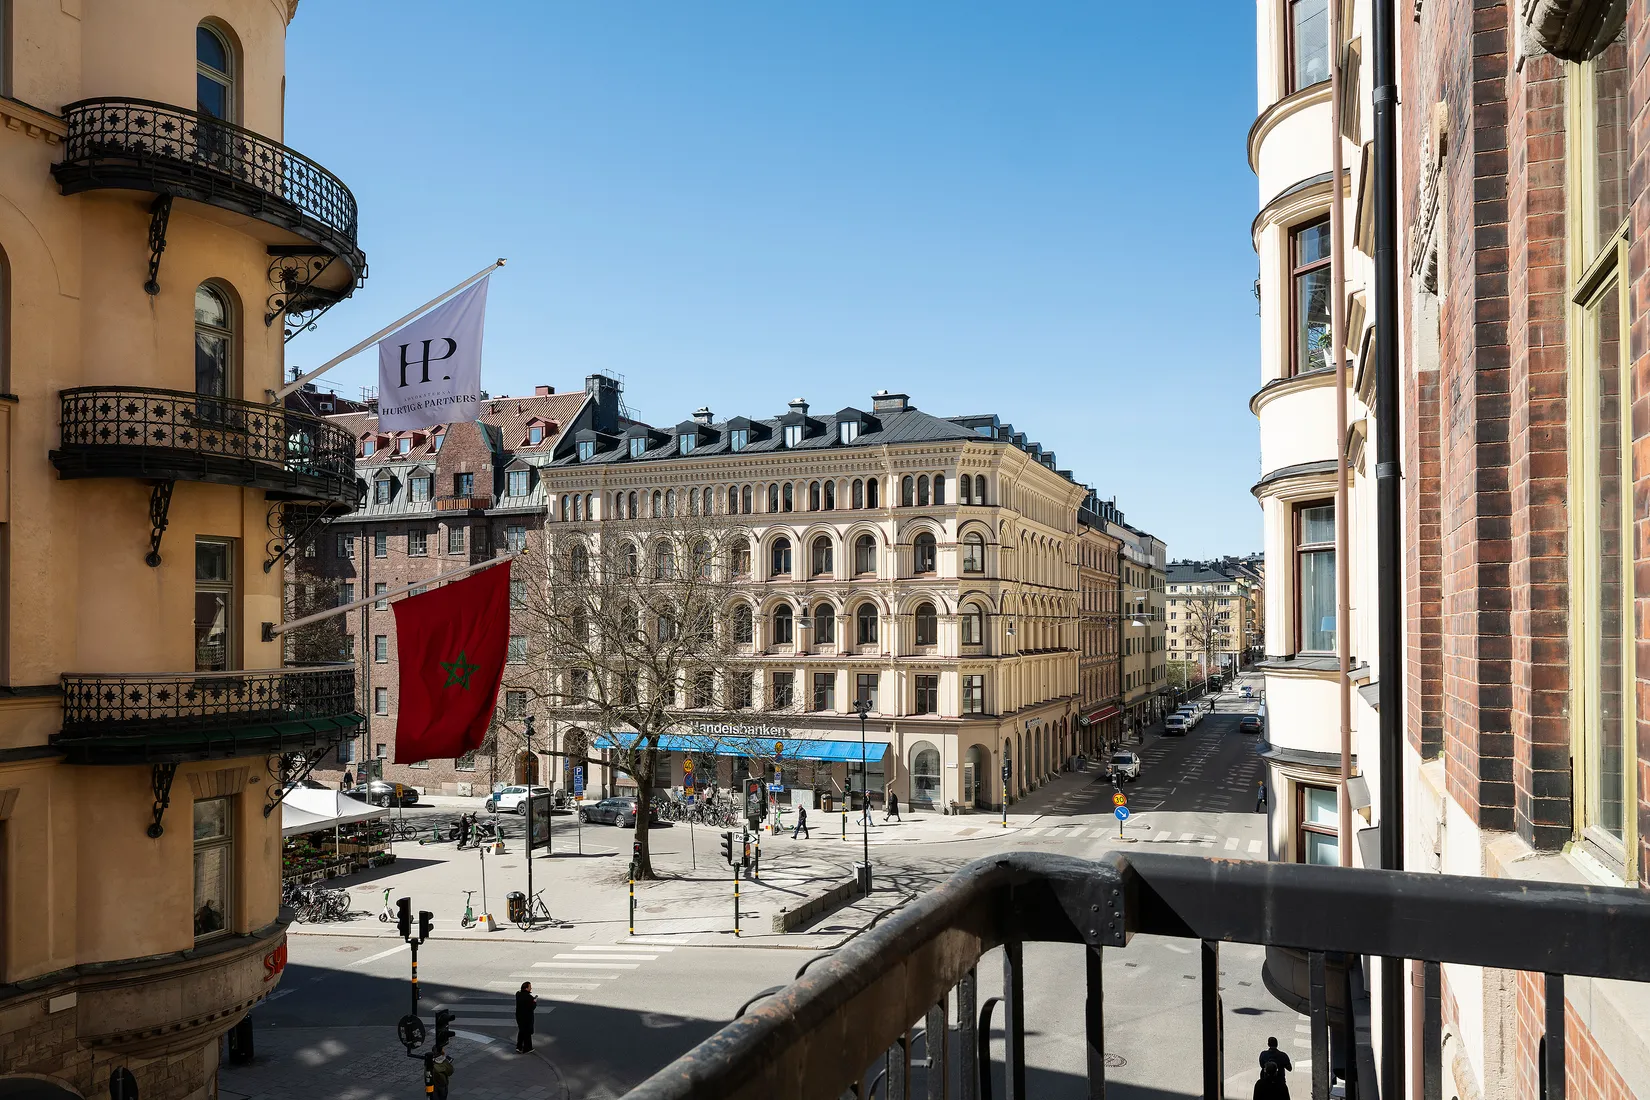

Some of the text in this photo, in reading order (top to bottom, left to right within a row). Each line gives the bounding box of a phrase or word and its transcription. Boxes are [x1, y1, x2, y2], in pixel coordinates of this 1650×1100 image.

[382, 394, 477, 415] HURTIG & PARTNERS
[576, 767, 582, 775] P
